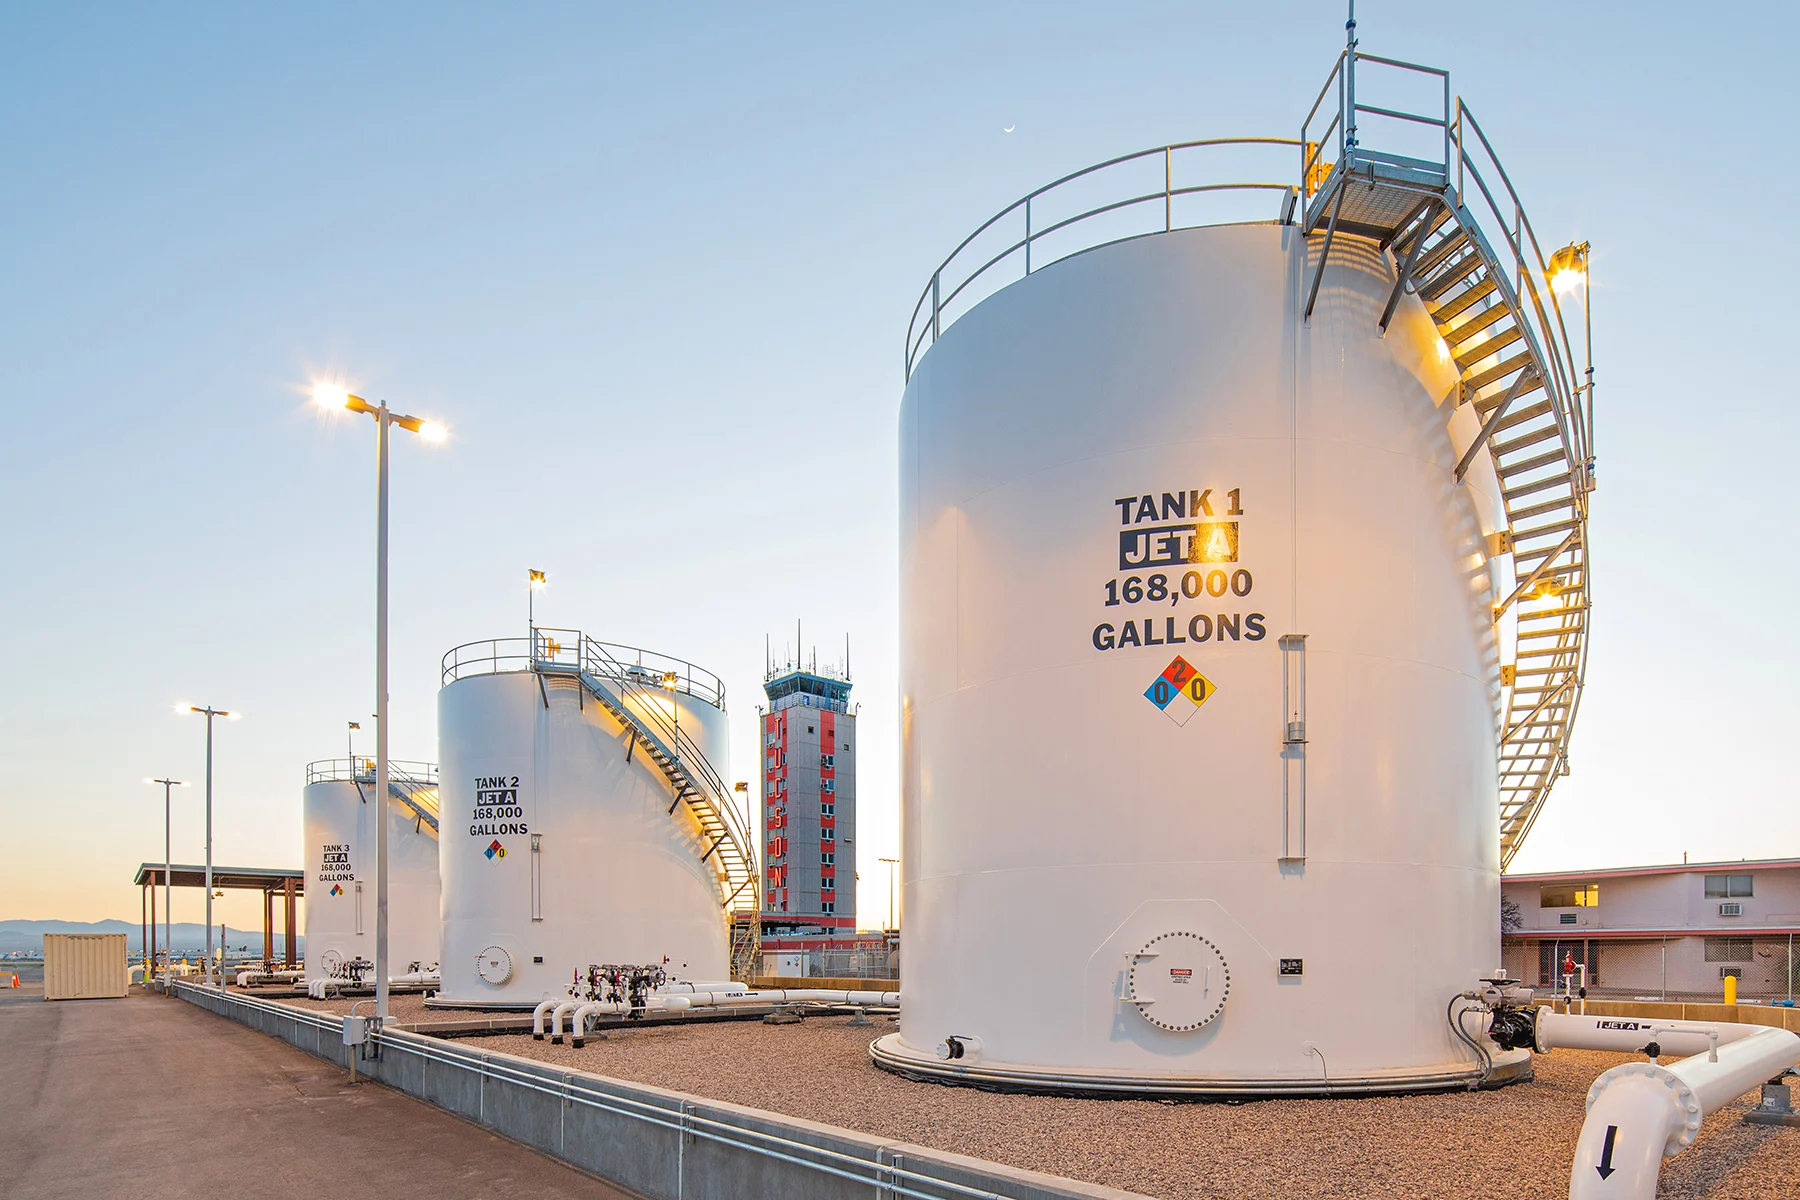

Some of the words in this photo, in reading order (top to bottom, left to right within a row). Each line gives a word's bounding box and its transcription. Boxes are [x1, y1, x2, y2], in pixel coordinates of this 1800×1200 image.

[1114, 488, 1214, 526] TANK
[1227, 487, 1244, 516] 1
[1125, 529, 1196, 565] JET
[1206, 527, 1232, 558] A
[1104, 568, 1253, 607] 168,000
[1092, 612, 1267, 651] GALLONS
[1171, 659, 1187, 683] 2
[1154, 681, 1169, 704] 0
[1191, 677, 1206, 702] 0
[474, 776, 507, 789] TANK
[510, 776, 519, 787] 2
[478, 791, 501, 804] JET
[504, 791, 515, 803] A
[773, 717, 782, 888] TUCSON
[472, 807, 523, 821] 168,000
[469, 823, 528, 836] GALLONS
[324, 854, 339, 862] JET
[340, 854, 347, 862] A
[499, 848, 505, 858] 0
[321, 863, 352, 872] 168,000
[319, 873, 355, 882] GALLONS
[1604, 1021, 1626, 1029] JET
